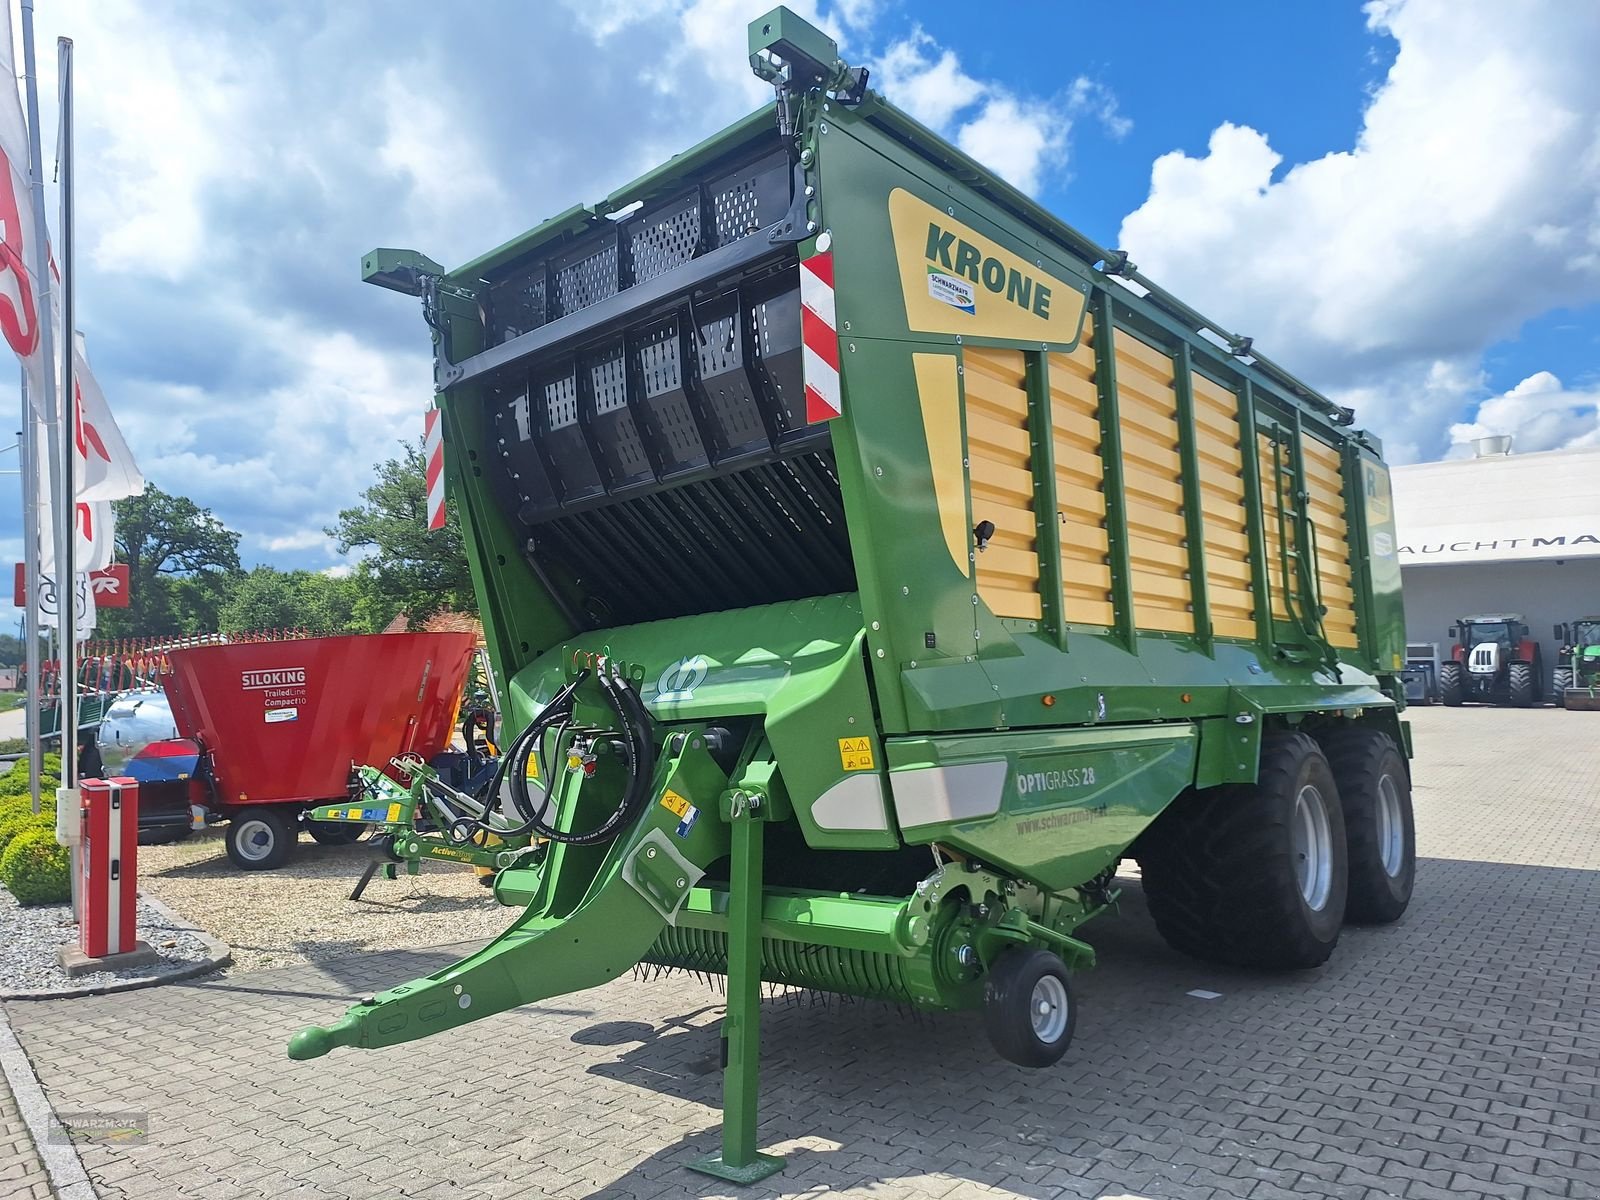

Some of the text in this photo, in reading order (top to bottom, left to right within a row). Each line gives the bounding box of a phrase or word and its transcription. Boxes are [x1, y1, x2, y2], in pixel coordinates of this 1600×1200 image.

[925, 222, 1052, 321] KRONE
[931, 274, 968, 296] SCHWARZMAYR
[242, 671, 305, 686] SILOKING
[264, 689, 306, 698] TrailedLine
[1017, 767, 1095, 794] OPTIGRASS 28
